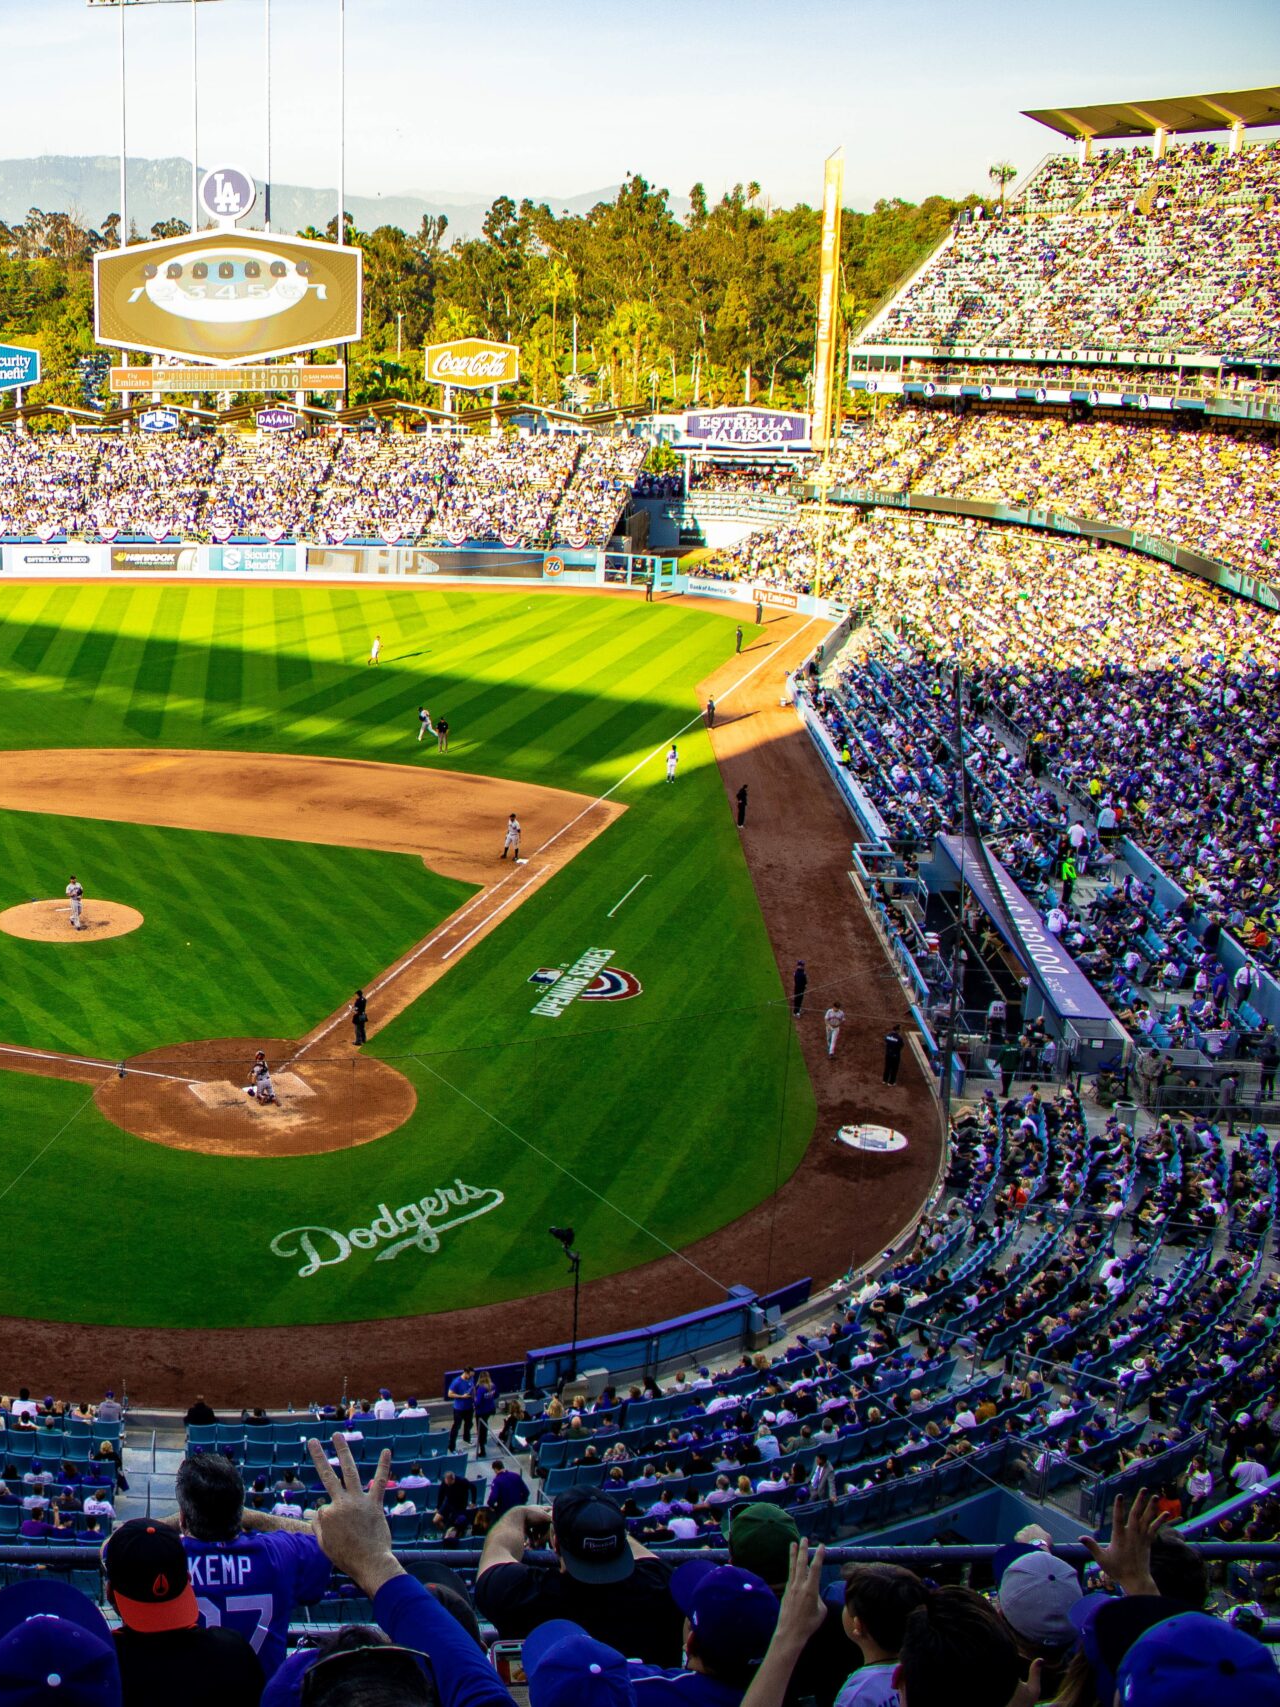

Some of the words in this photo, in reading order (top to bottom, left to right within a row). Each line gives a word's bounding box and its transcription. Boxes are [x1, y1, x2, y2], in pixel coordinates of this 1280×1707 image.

[213, 174, 241, 212] LA
[933, 346, 1014, 359] DODGER
[1030, 351, 1118, 363] STADIUM
[1134, 353, 1176, 365] CLUB
[259, 414, 293, 425] DASANI
[698, 416, 793, 430] ESTRELLA
[707, 429, 783, 442] JALISCO
[244, 550, 282, 562] Security
[245, 560, 277, 570] Benefit
[567, 946, 617, 978] SERIES
[530, 975, 591, 1018] OPENING
[270, 1178, 504, 1278] Dodgers
[188, 1554, 252, 1586] KEMP
